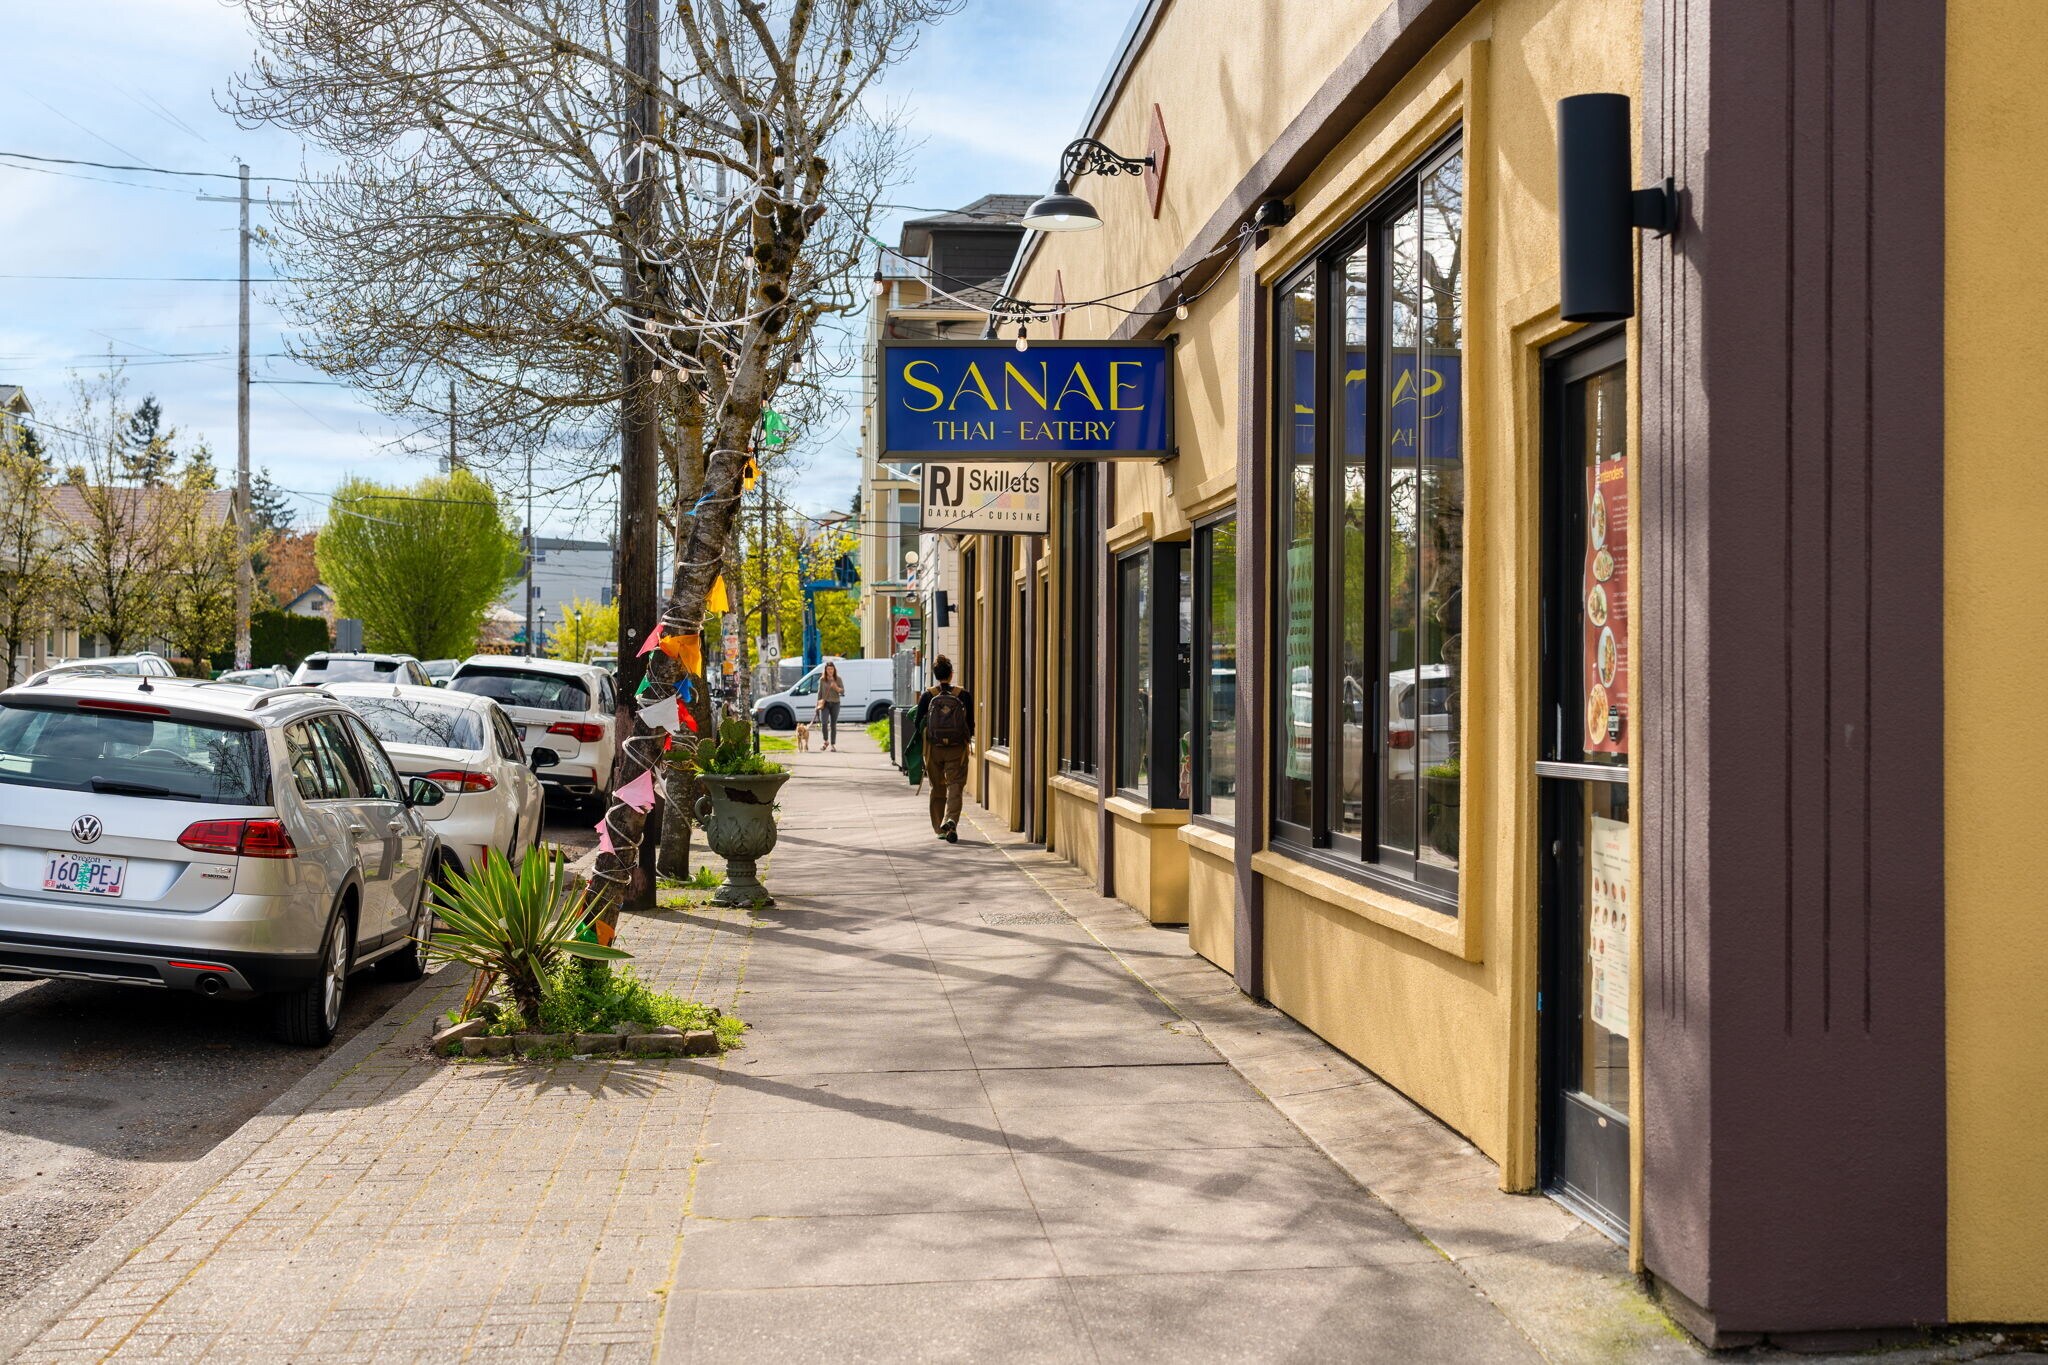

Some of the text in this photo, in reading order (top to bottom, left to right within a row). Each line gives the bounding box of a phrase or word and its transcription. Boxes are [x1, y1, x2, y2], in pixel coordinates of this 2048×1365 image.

[903, 360, 1145, 412] SANAE
[933, 421, 995, 441] THAI
[1020, 421, 1116, 441] EATERY
[929, 465, 1040, 507] RJ Skillets
[928, 508, 974, 519] OAXACA
[988, 511, 1041, 522] CUISINE
[895, 625, 909, 636] STOP
[71, 853, 101, 864] Oregon
[49, 860, 122, 886] 160 PEJ
